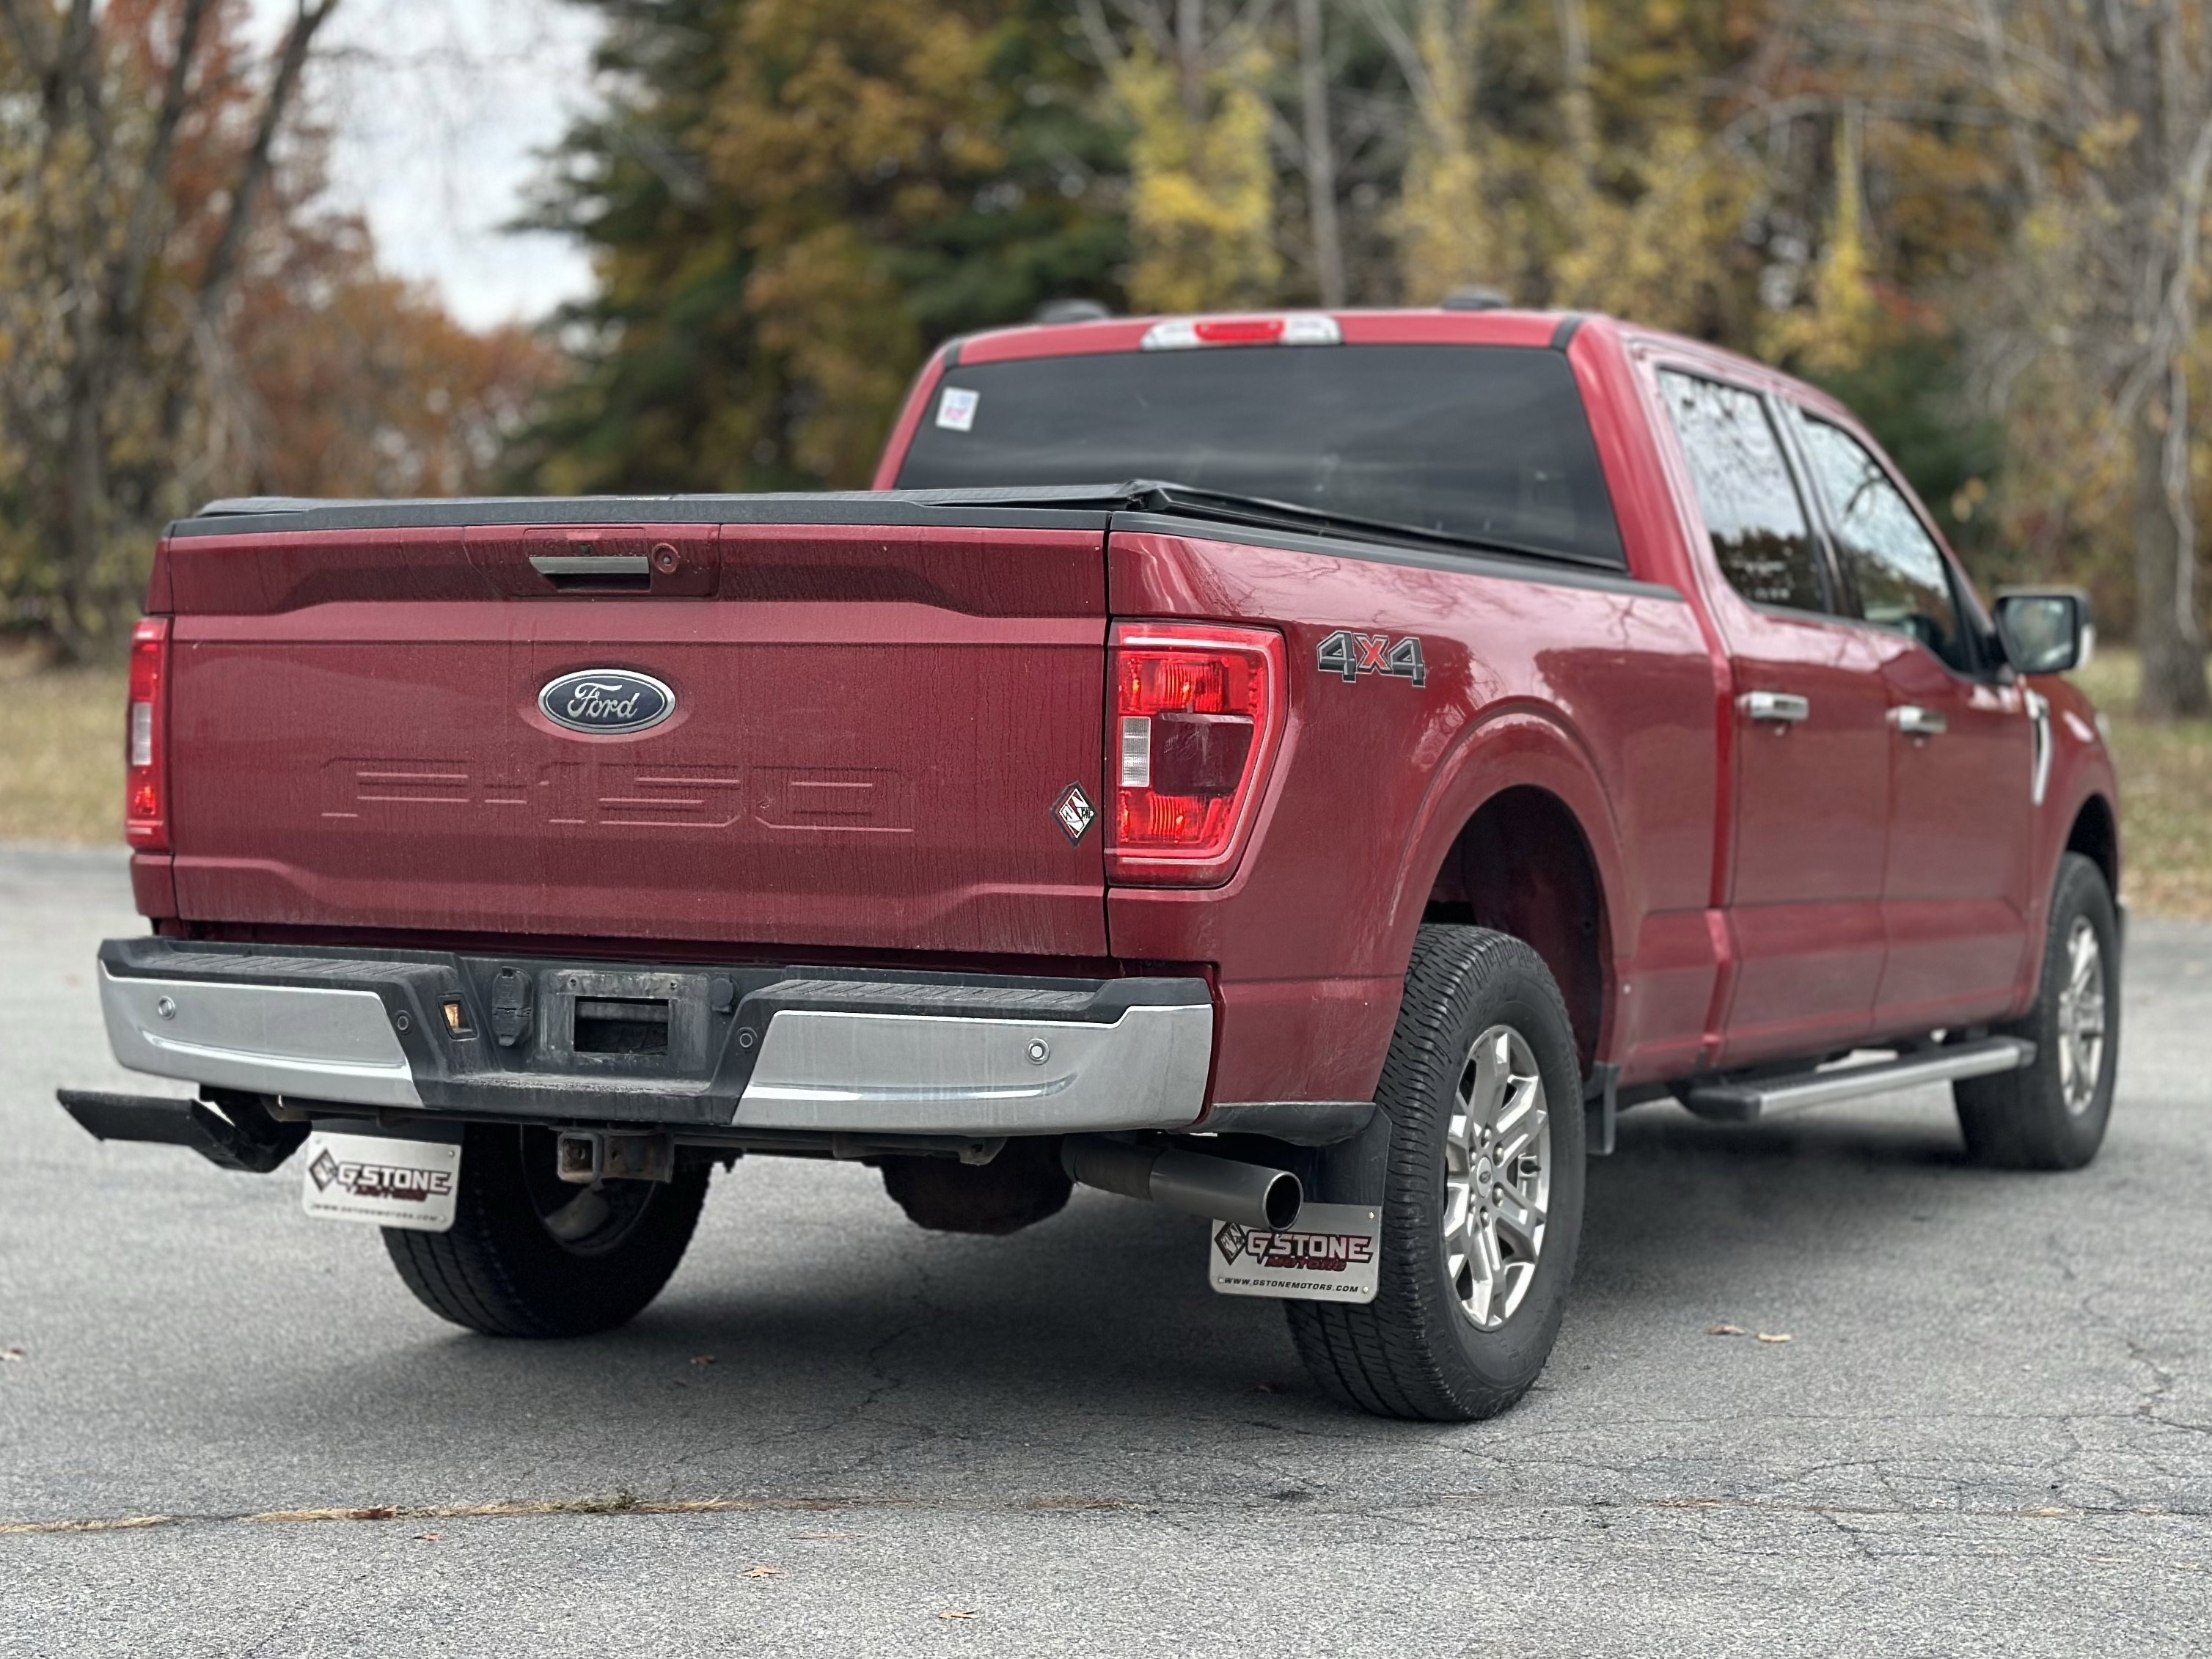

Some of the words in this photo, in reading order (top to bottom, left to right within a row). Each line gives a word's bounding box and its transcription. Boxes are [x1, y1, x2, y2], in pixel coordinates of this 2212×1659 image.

[567, 682, 640, 718] Ford
[337, 1161, 453, 1195] GSTONE
[1246, 1230, 1373, 1263] GSTONE
[1224, 1277, 1359, 1293] WWW.GSTONEMOTORS.COM
